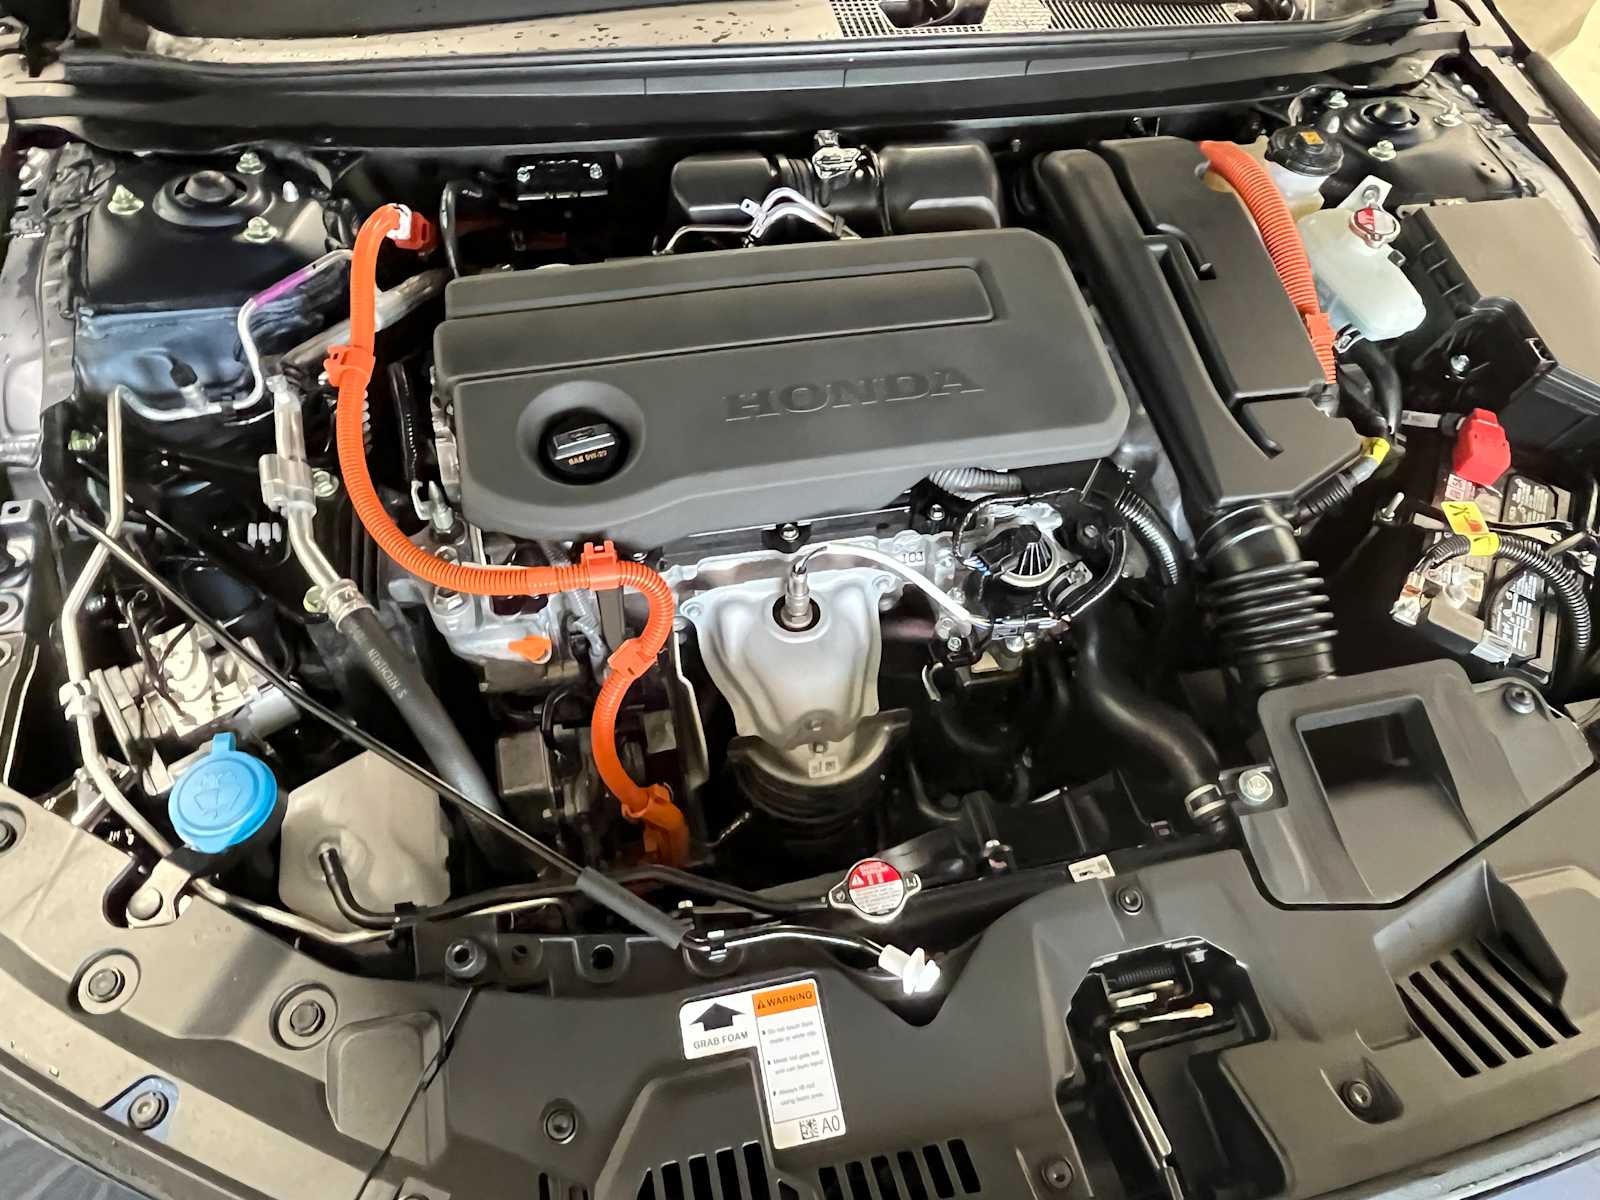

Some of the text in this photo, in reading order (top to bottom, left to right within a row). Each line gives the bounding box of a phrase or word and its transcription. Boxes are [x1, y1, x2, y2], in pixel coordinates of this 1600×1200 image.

[722, 367, 984, 422] HONDA
[766, 990, 813, 1007] WARNING
[693, 1031, 749, 1049] GRAB FOAM
[821, 1114, 840, 1133] A0
